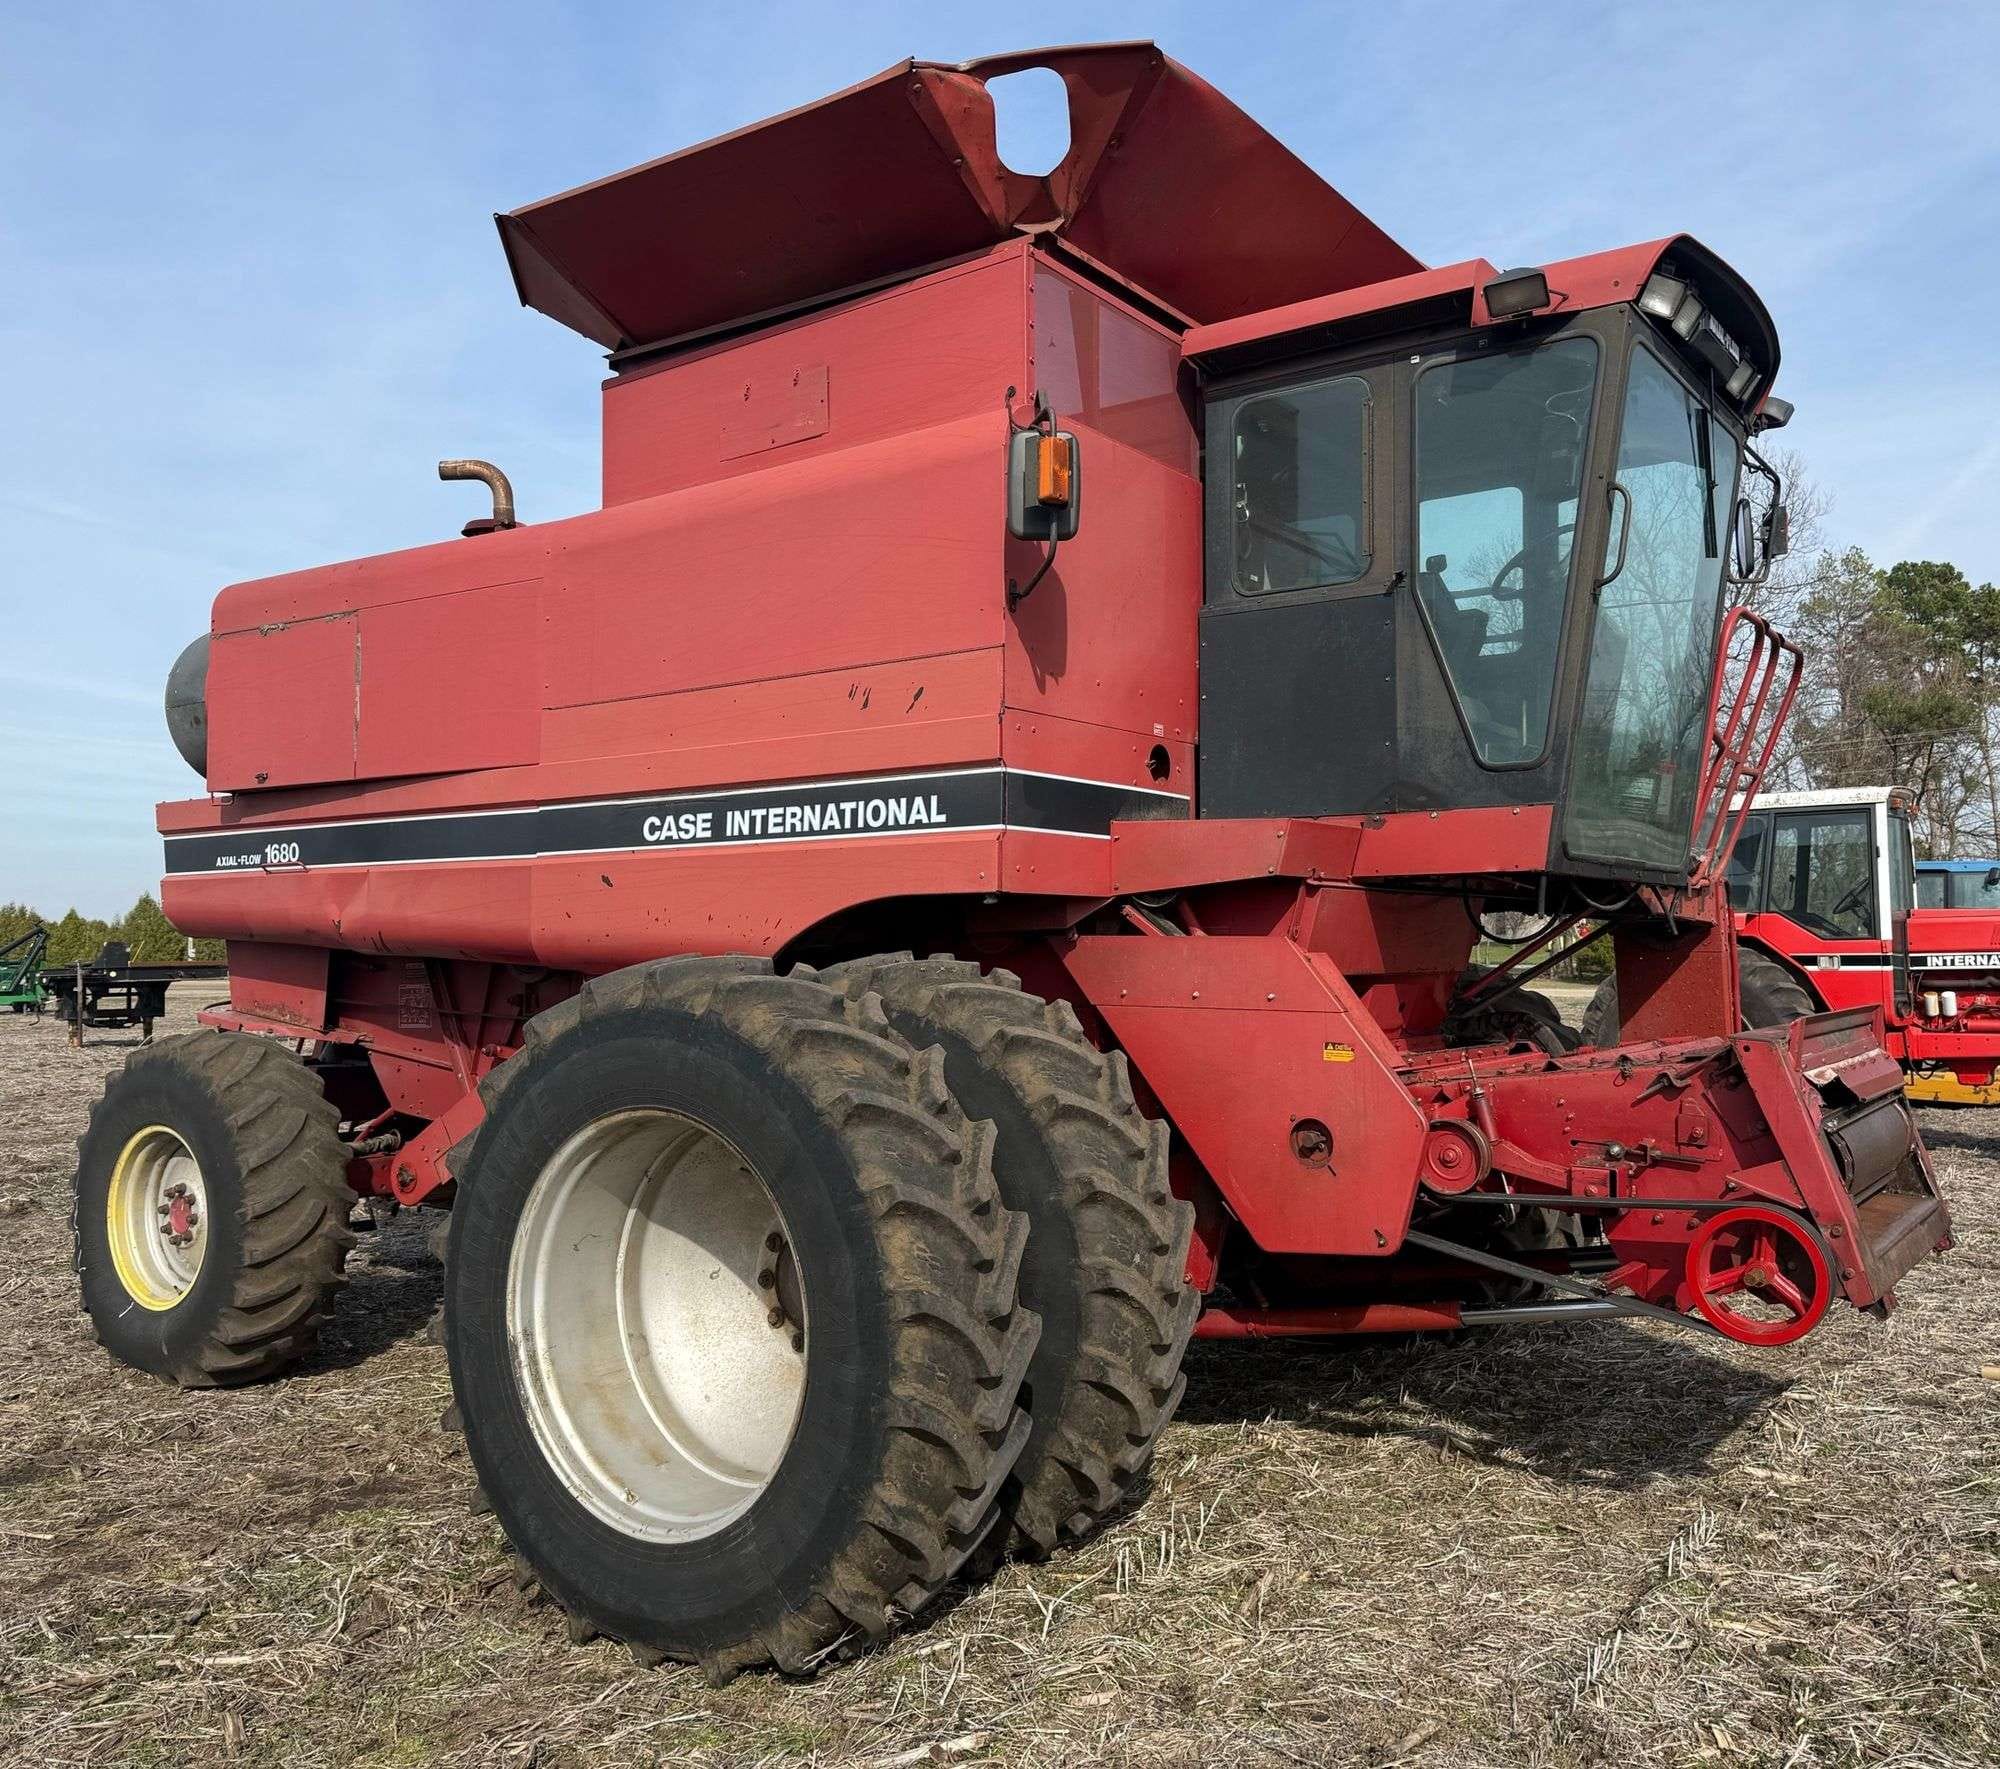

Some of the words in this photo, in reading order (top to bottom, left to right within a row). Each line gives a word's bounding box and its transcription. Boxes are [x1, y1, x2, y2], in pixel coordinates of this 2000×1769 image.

[642, 812, 712, 841] CASE
[725, 795, 947, 837] INTERNATIONAL
[264, 842, 300, 864] 1680
[1926, 955, 2000, 967] INTERNA
